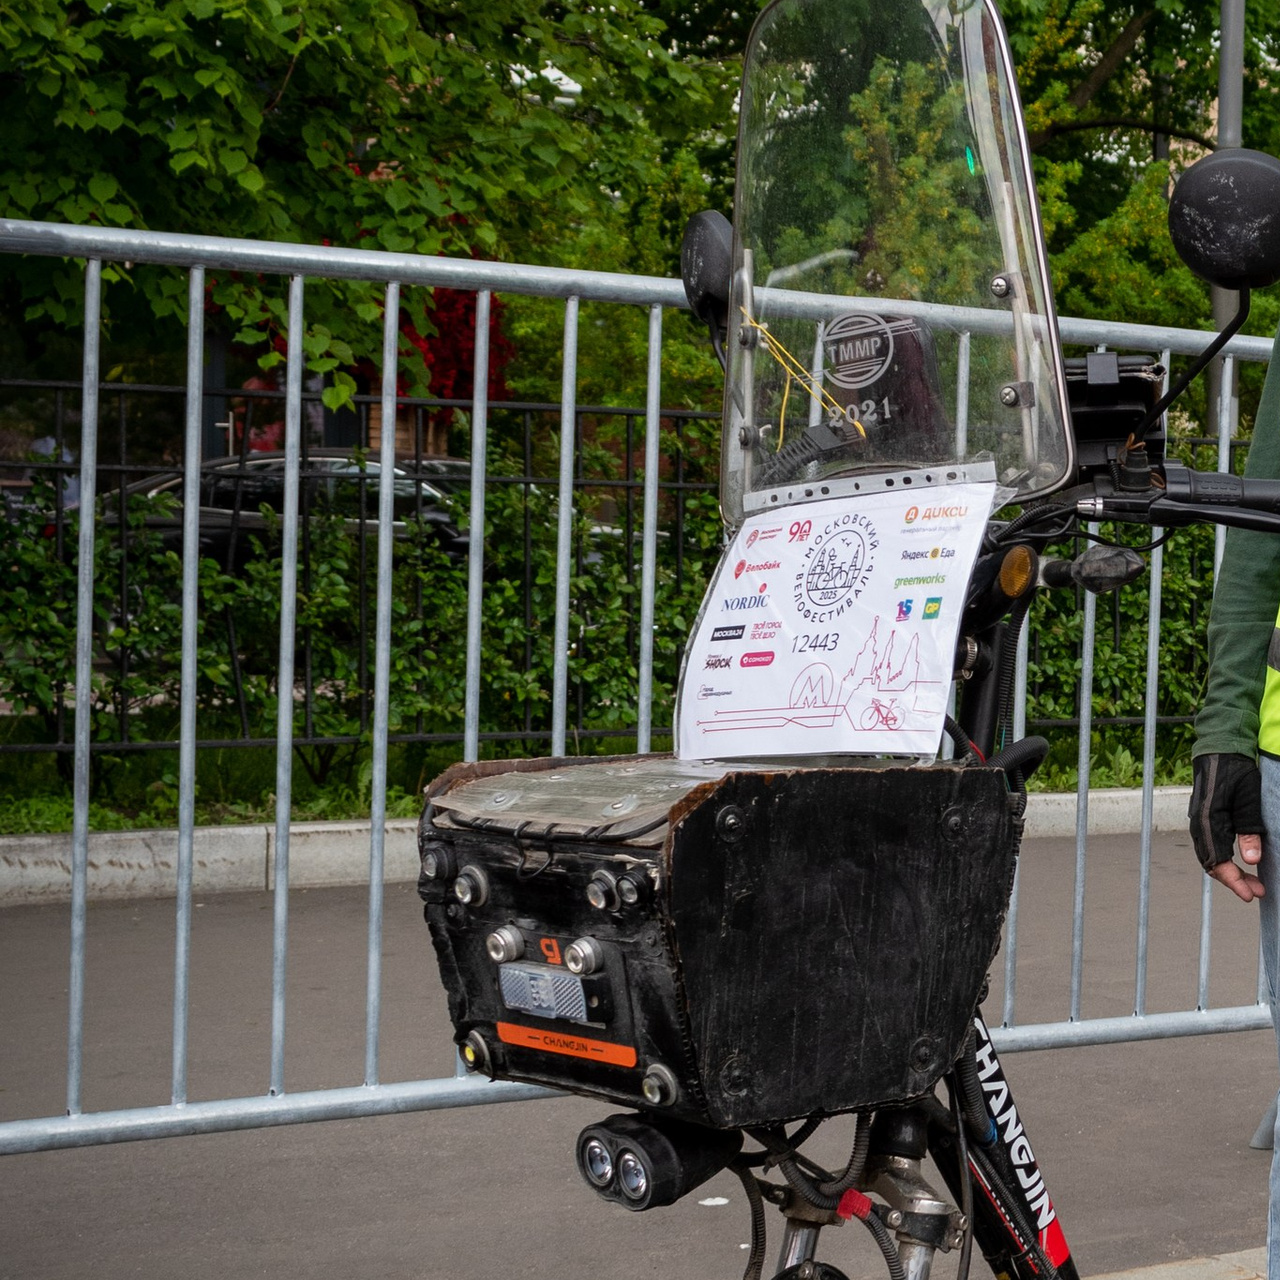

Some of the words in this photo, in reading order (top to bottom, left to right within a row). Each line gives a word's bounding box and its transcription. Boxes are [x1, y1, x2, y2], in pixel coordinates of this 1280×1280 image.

[827, 337, 881, 363] TMMP
[828, 396, 891, 428] 2021
[804, 514, 879, 559] МОСКОВСКИЙ
[901, 550, 929, 561] Яндекс
[940, 548, 956, 558] Еда
[745, 560, 782, 573] Велобайк
[893, 572, 946, 589] greenworks
[794, 565, 873, 623] ВЕЛОФЕСТИВАЛЬ
[819, 591, 838, 600] 2025
[720, 594, 770, 612] NORDIC
[792, 633, 840, 653] 12443
[702, 656, 733, 670] SHOCK
[543, 1036, 588, 1052] CHANGJIN
